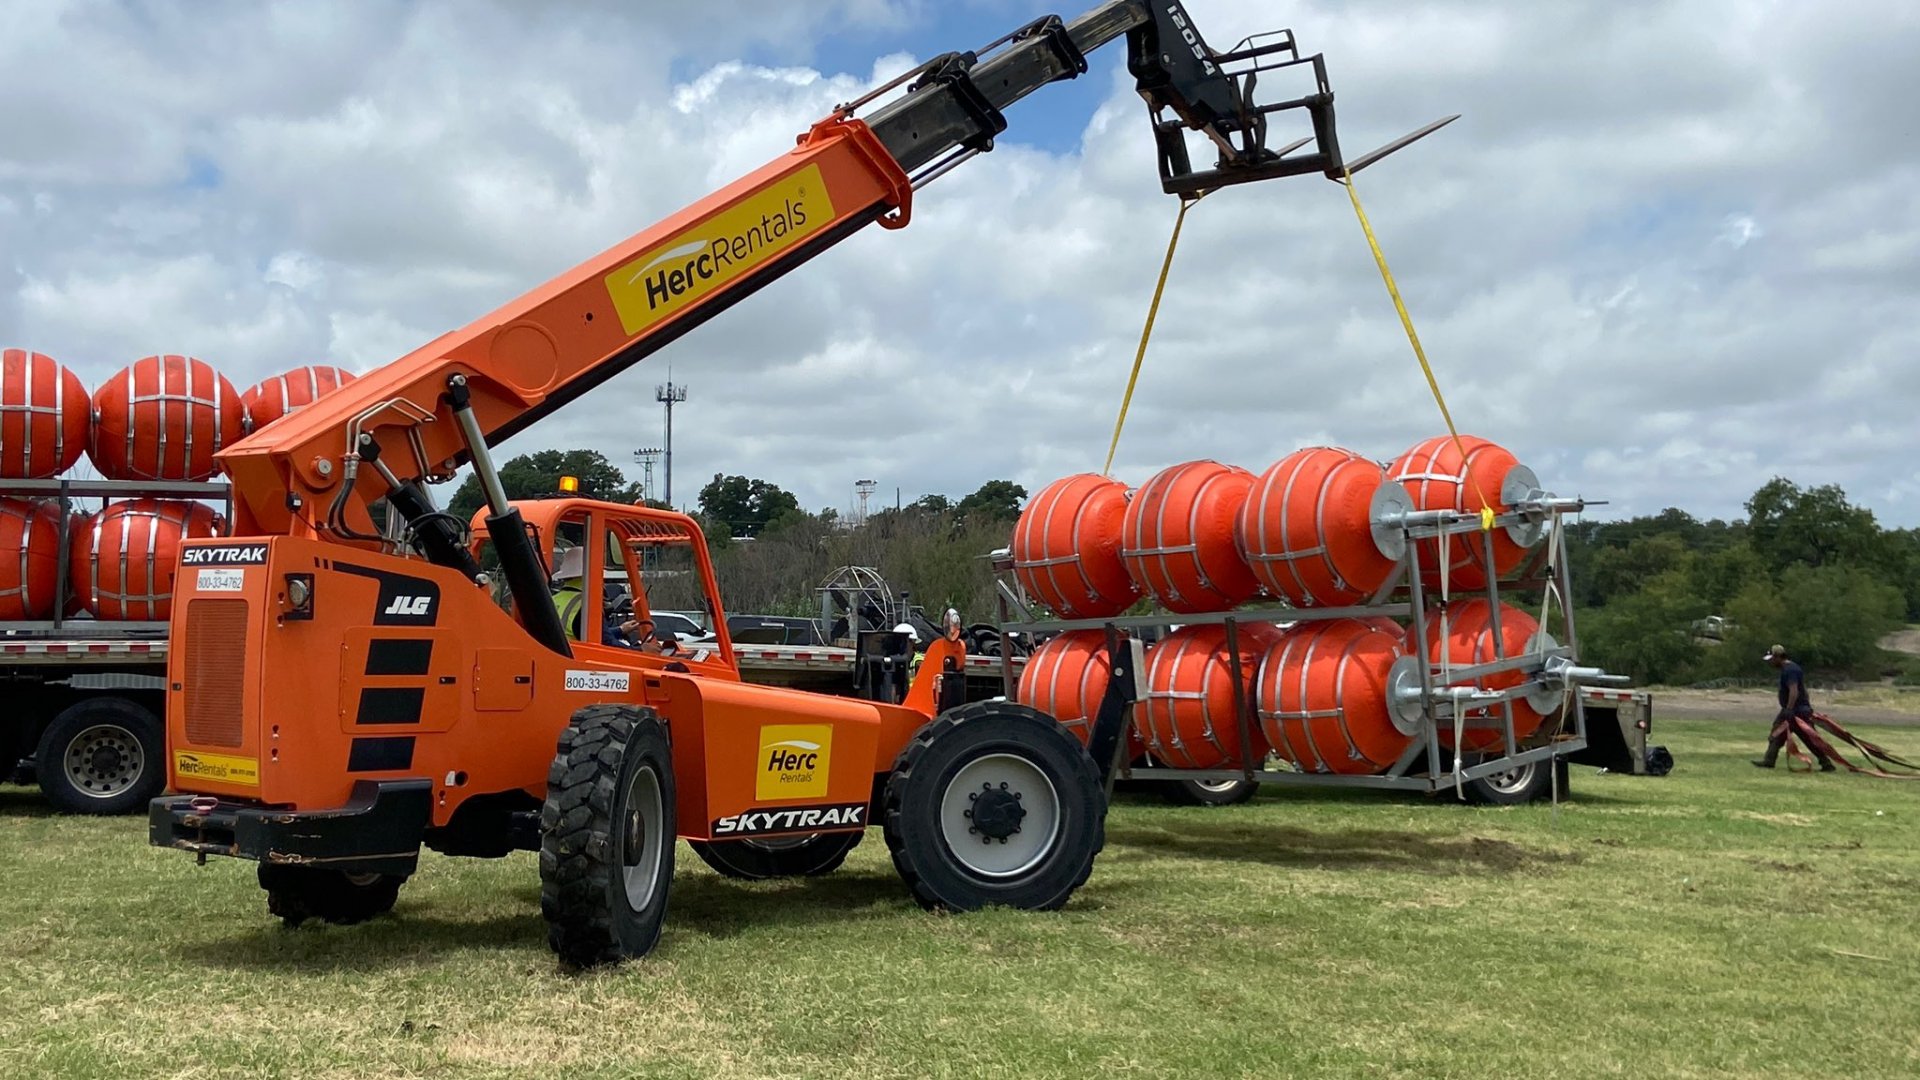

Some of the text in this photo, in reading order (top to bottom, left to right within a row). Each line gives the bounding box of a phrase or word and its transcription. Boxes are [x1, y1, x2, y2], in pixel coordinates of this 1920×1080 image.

[1166, 5, 1216, 76] 12054
[183, 547, 266, 562] SKYTRAK
[198, 576, 242, 589] 800-33-4762
[384, 596, 431, 615] JLG
[566, 677, 628, 690] 800-33-4762
[767, 748, 818, 772] Herc
[780, 771, 813, 783] Rentals
[715, 805, 865, 834] SKYTRAK
